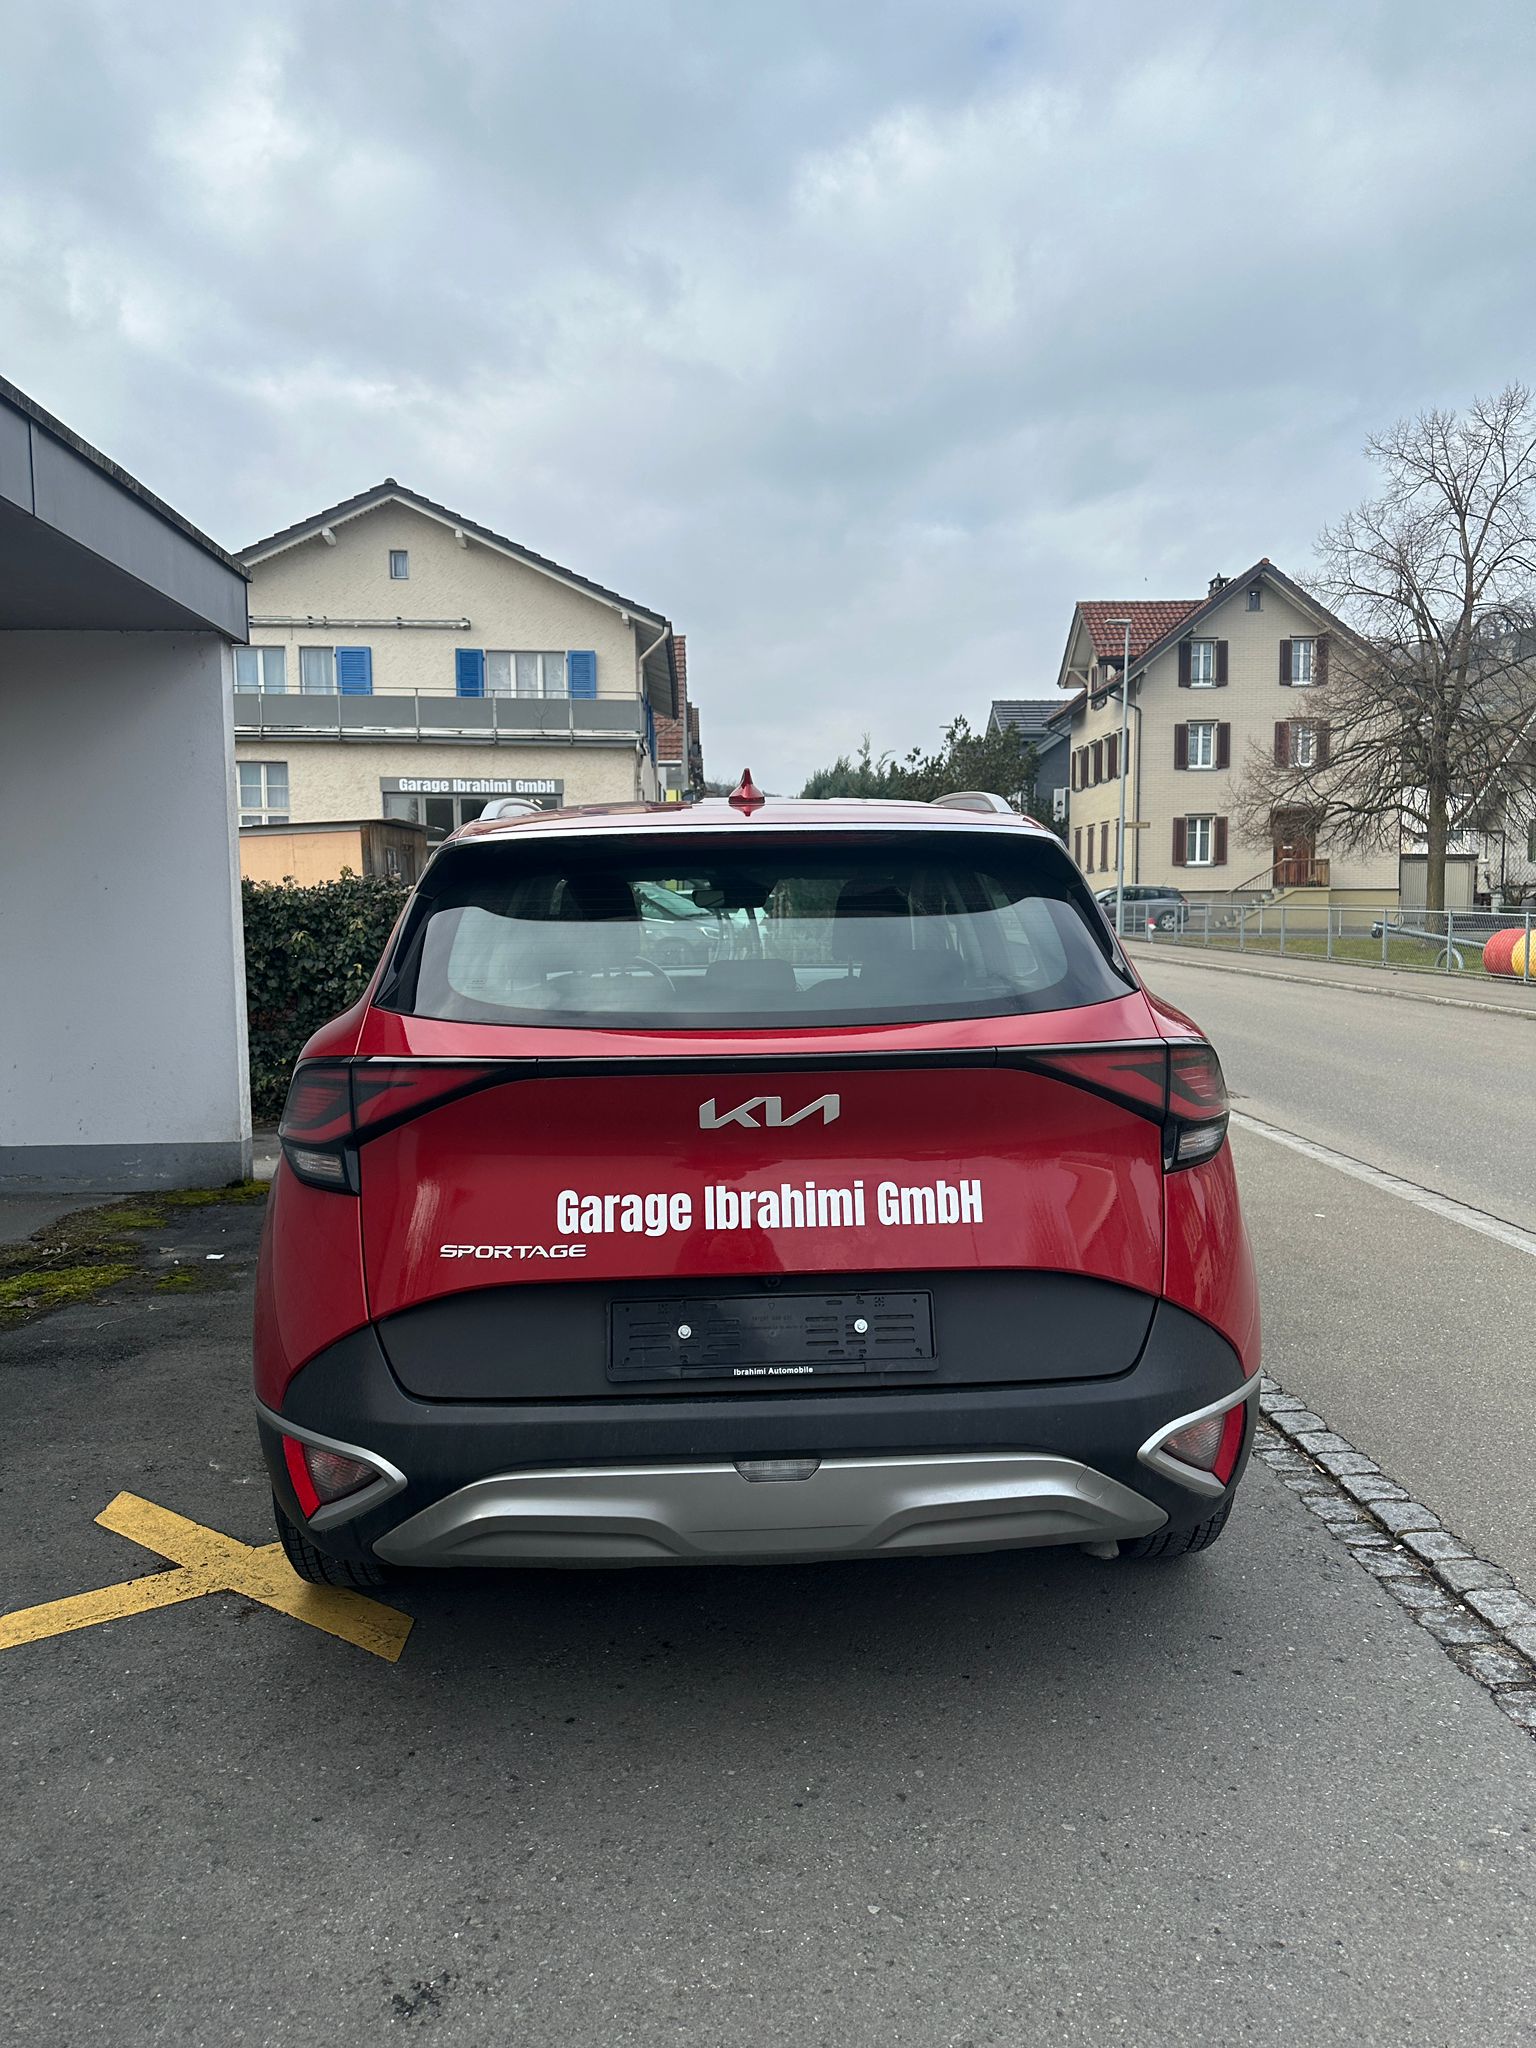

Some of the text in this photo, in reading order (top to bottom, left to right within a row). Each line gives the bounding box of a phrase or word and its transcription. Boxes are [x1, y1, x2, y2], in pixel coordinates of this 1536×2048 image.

[398, 778, 556, 793] Garage Ibrahimi GmbH
[556, 1178, 984, 1237] Garage Ibrahimi GmbH
[439, 1243, 588, 1260] SPORTAGE
[733, 1366, 814, 1376] Ibrahimi Automobile
